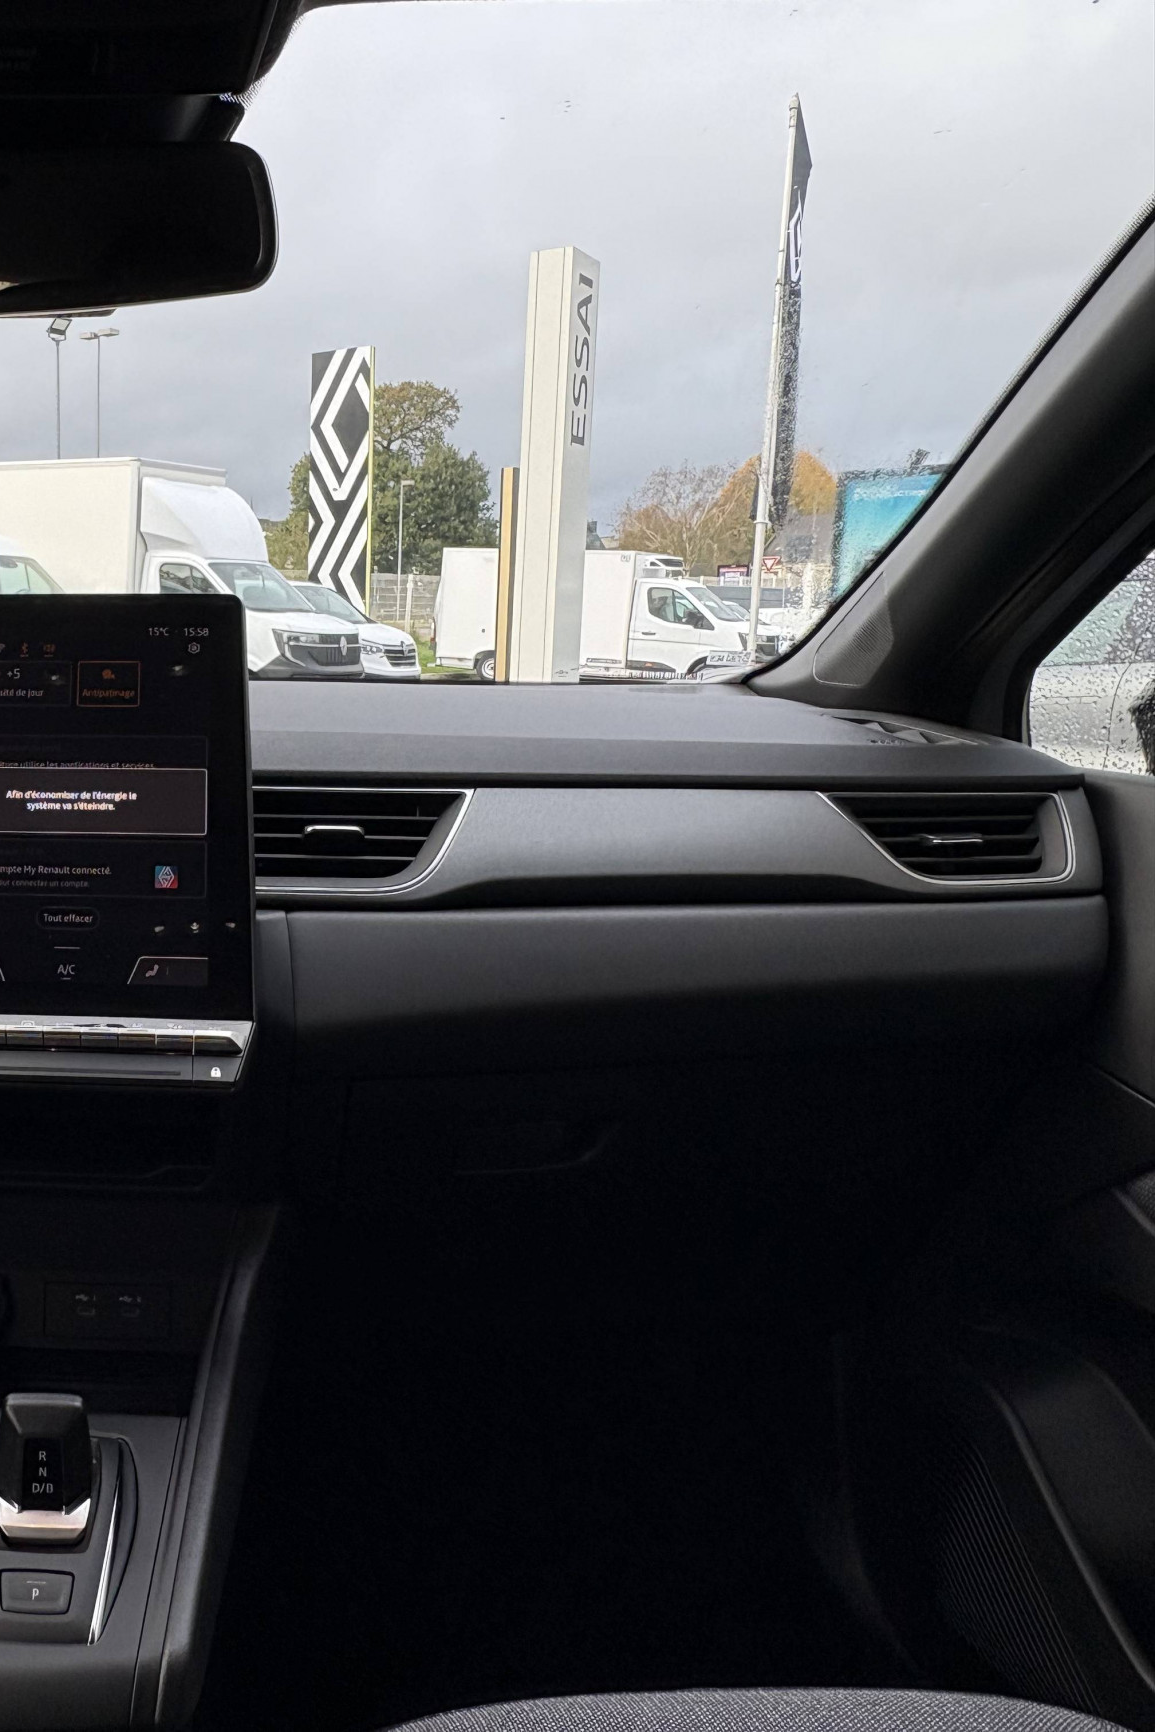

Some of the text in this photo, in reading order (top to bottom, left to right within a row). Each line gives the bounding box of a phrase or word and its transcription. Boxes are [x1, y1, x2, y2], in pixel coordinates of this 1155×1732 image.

[570, 273, 594, 447] ESSAI
[7, 668, 21, 679] +5
[6, 790, 23, 799] Afin
[80, 790, 91, 800] de
[129, 791, 137, 800] le
[26, 802, 60, 811] système
[62, 802, 72, 810] va
[23, 865, 37, 876] My
[38, 865, 70, 874] Renault
[43, 913, 94, 923] Tout effacer
[57, 964, 76, 975] A/C
[38, 1451, 47, 1461] R
[38, 1467, 47, 1477] N
[32, 1483, 54, 1494] D/B
[32, 1588, 40, 1600] P
